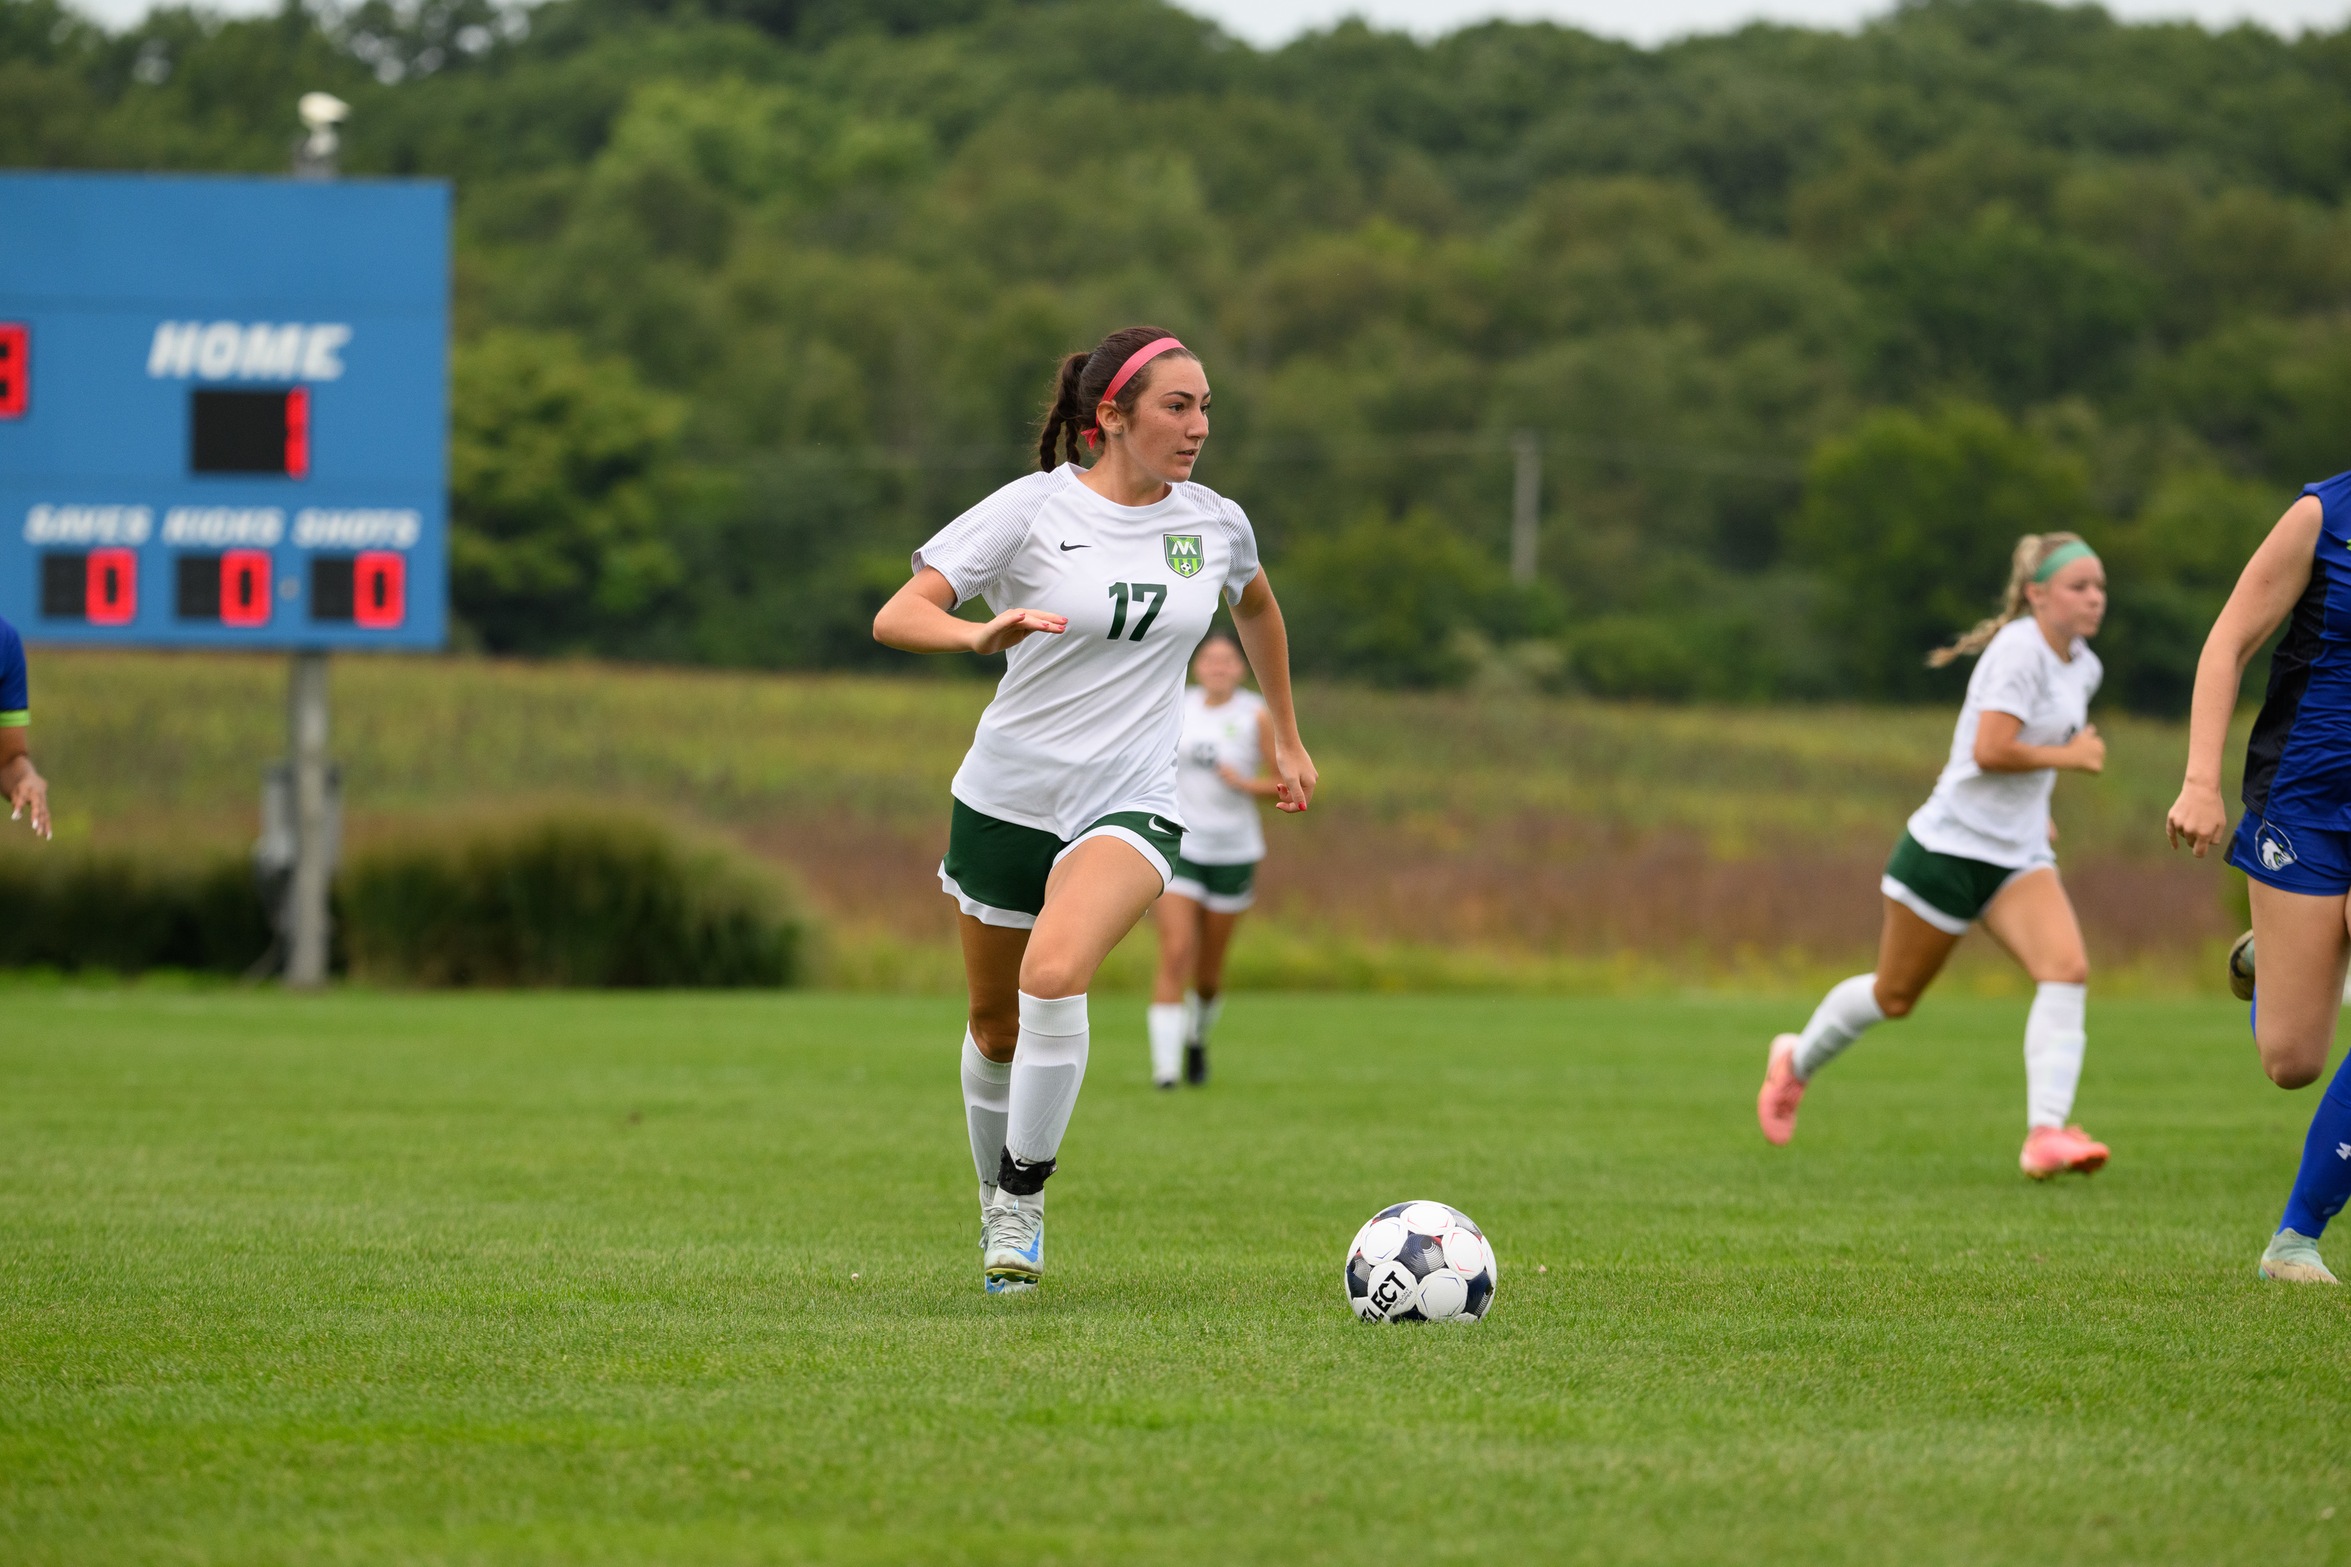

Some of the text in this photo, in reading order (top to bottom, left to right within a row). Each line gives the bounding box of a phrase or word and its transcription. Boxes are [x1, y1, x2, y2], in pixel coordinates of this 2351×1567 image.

[148, 321, 353, 381] HOME
[285, 385, 310, 480] 1
[25, 505, 151, 545] SAVES
[163, 507, 284, 547] KICKS
[292, 509, 419, 549] SHOTS
[86, 547, 137, 626] 0
[219, 549, 272, 628] 0
[353, 551, 406, 629] 0
[1107, 582, 1167, 642] 17
